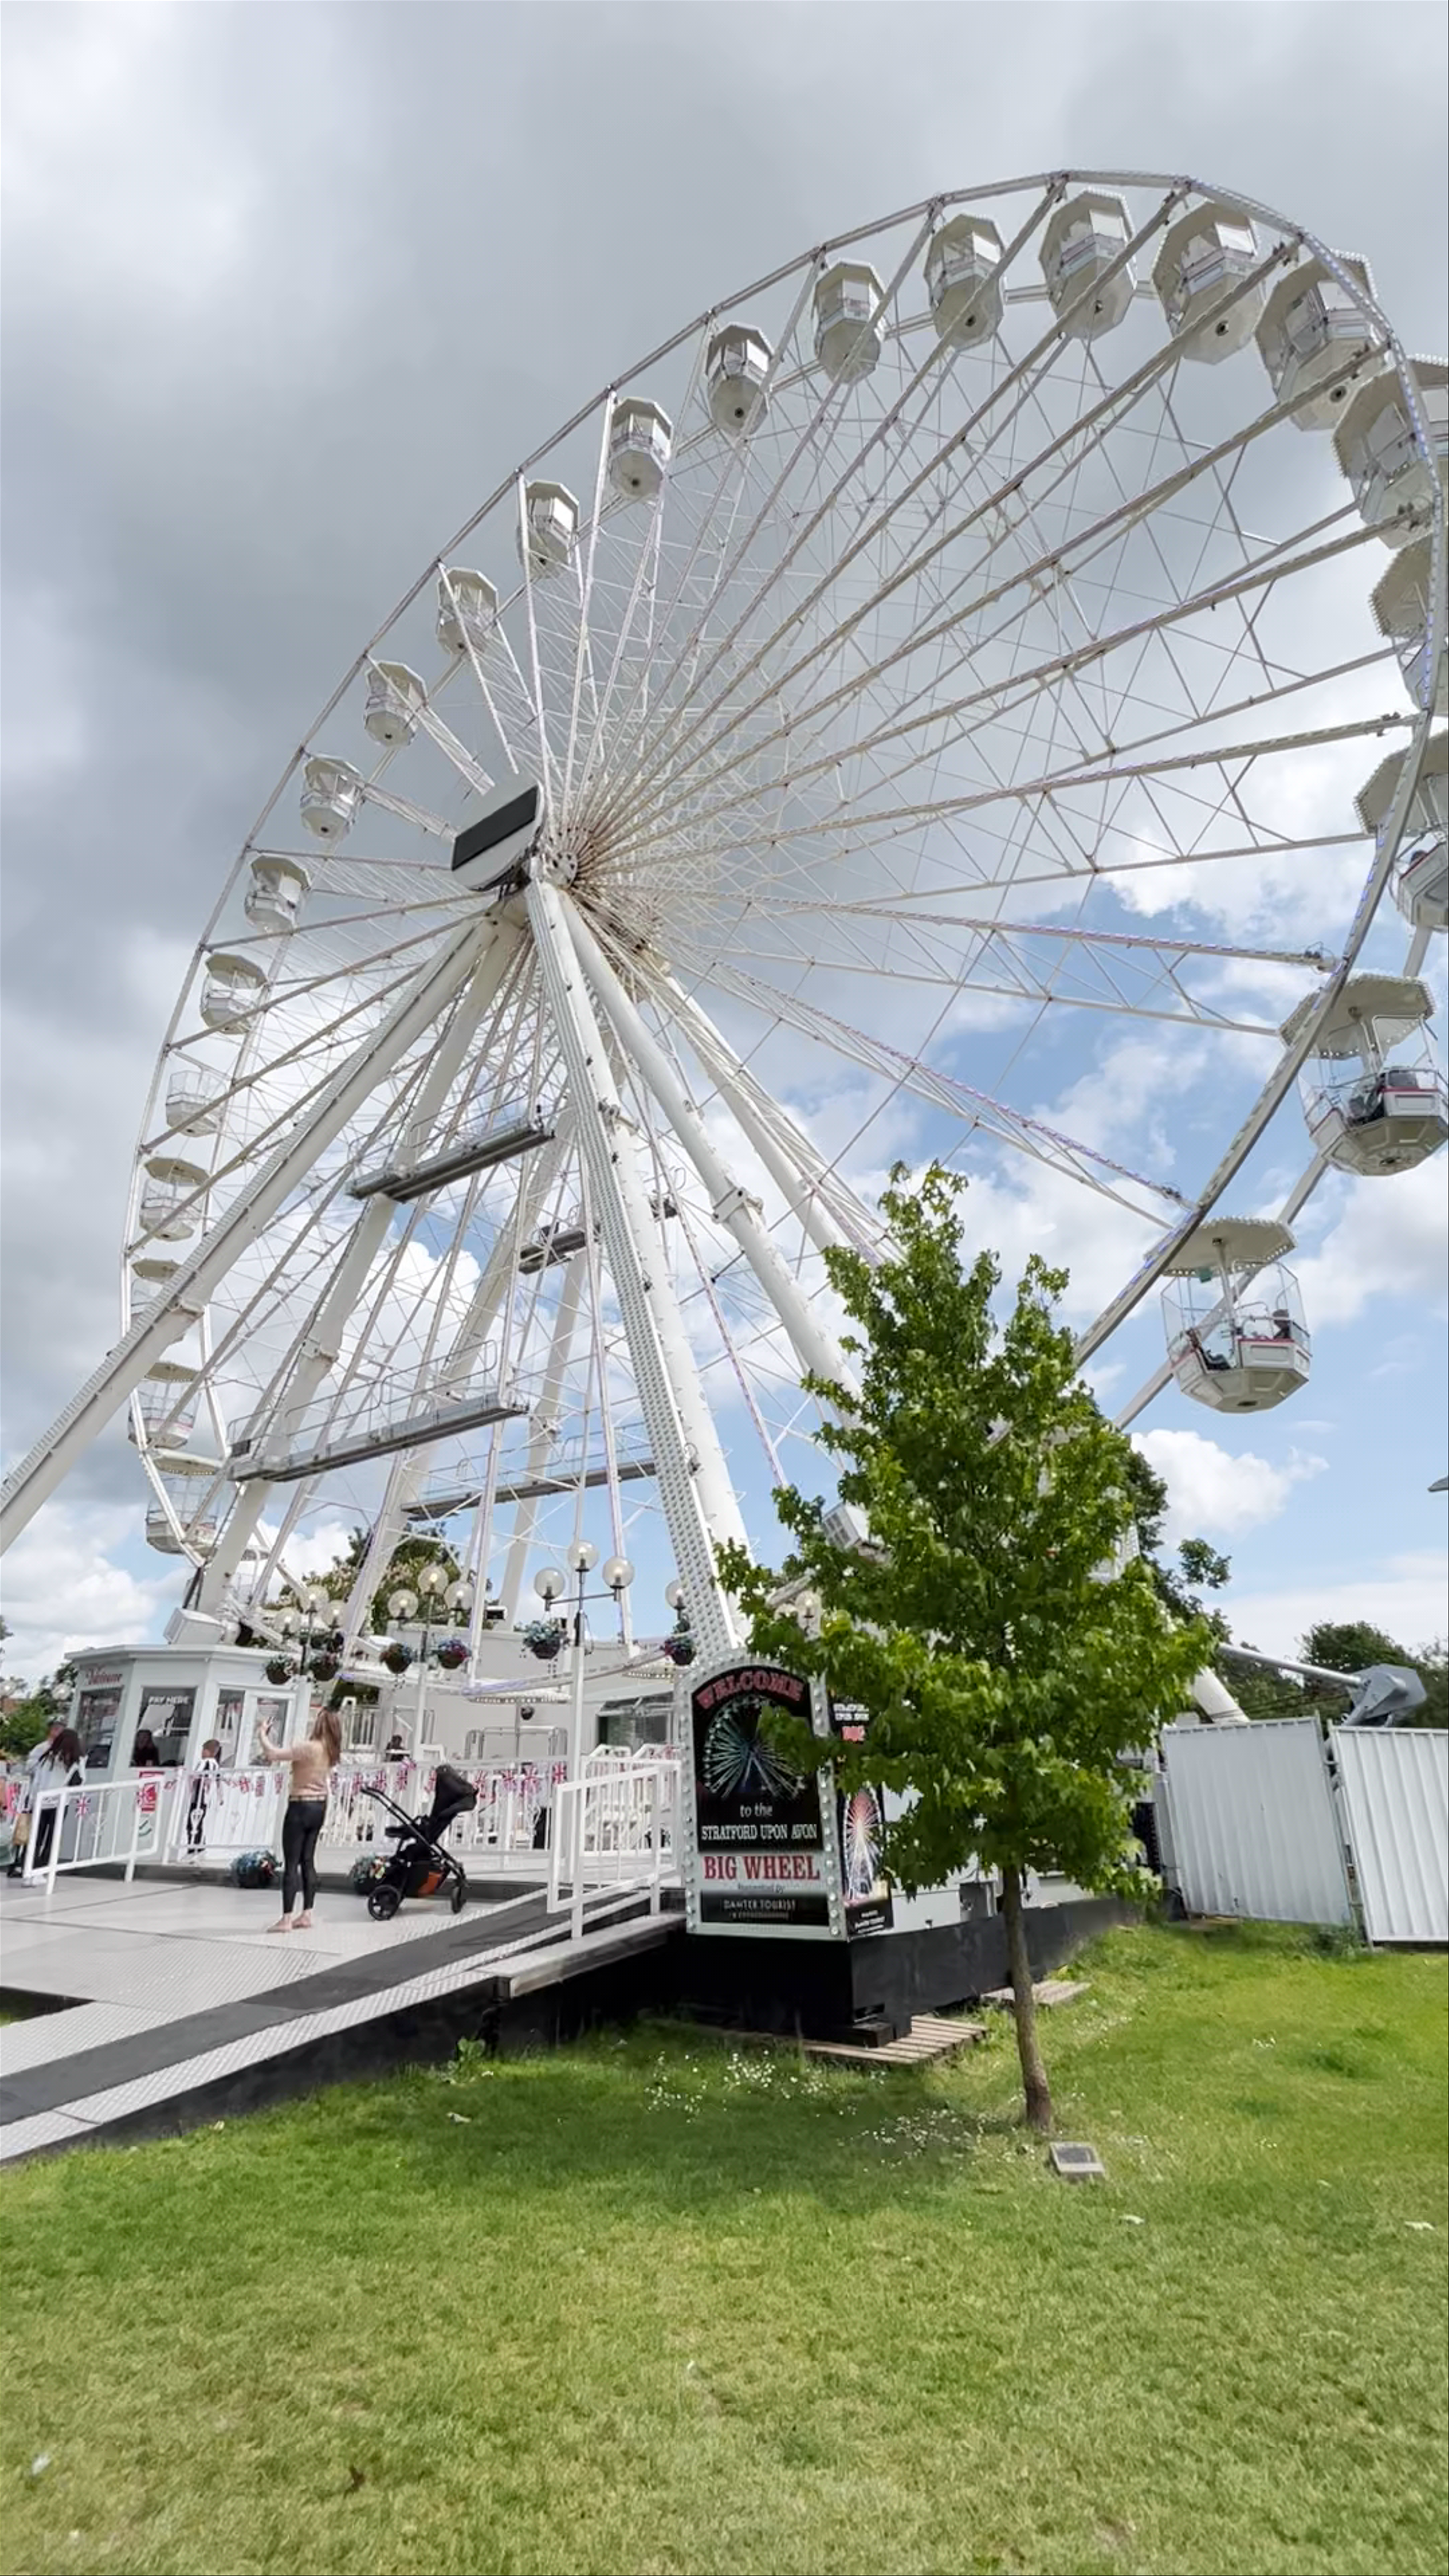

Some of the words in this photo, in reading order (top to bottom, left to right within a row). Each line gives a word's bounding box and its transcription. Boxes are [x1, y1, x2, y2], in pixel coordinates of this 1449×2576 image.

[697, 1670, 804, 1709] WELCOME
[740, 1804, 752, 1817] to
[755, 1803, 773, 1817] the
[701, 1824, 757, 1840] STRATFORD
[760, 1824, 788, 1839] UPON
[791, 1824, 817, 1839] AVON
[703, 1855, 737, 1879] BIG
[742, 1855, 820, 1880] WHEEL
